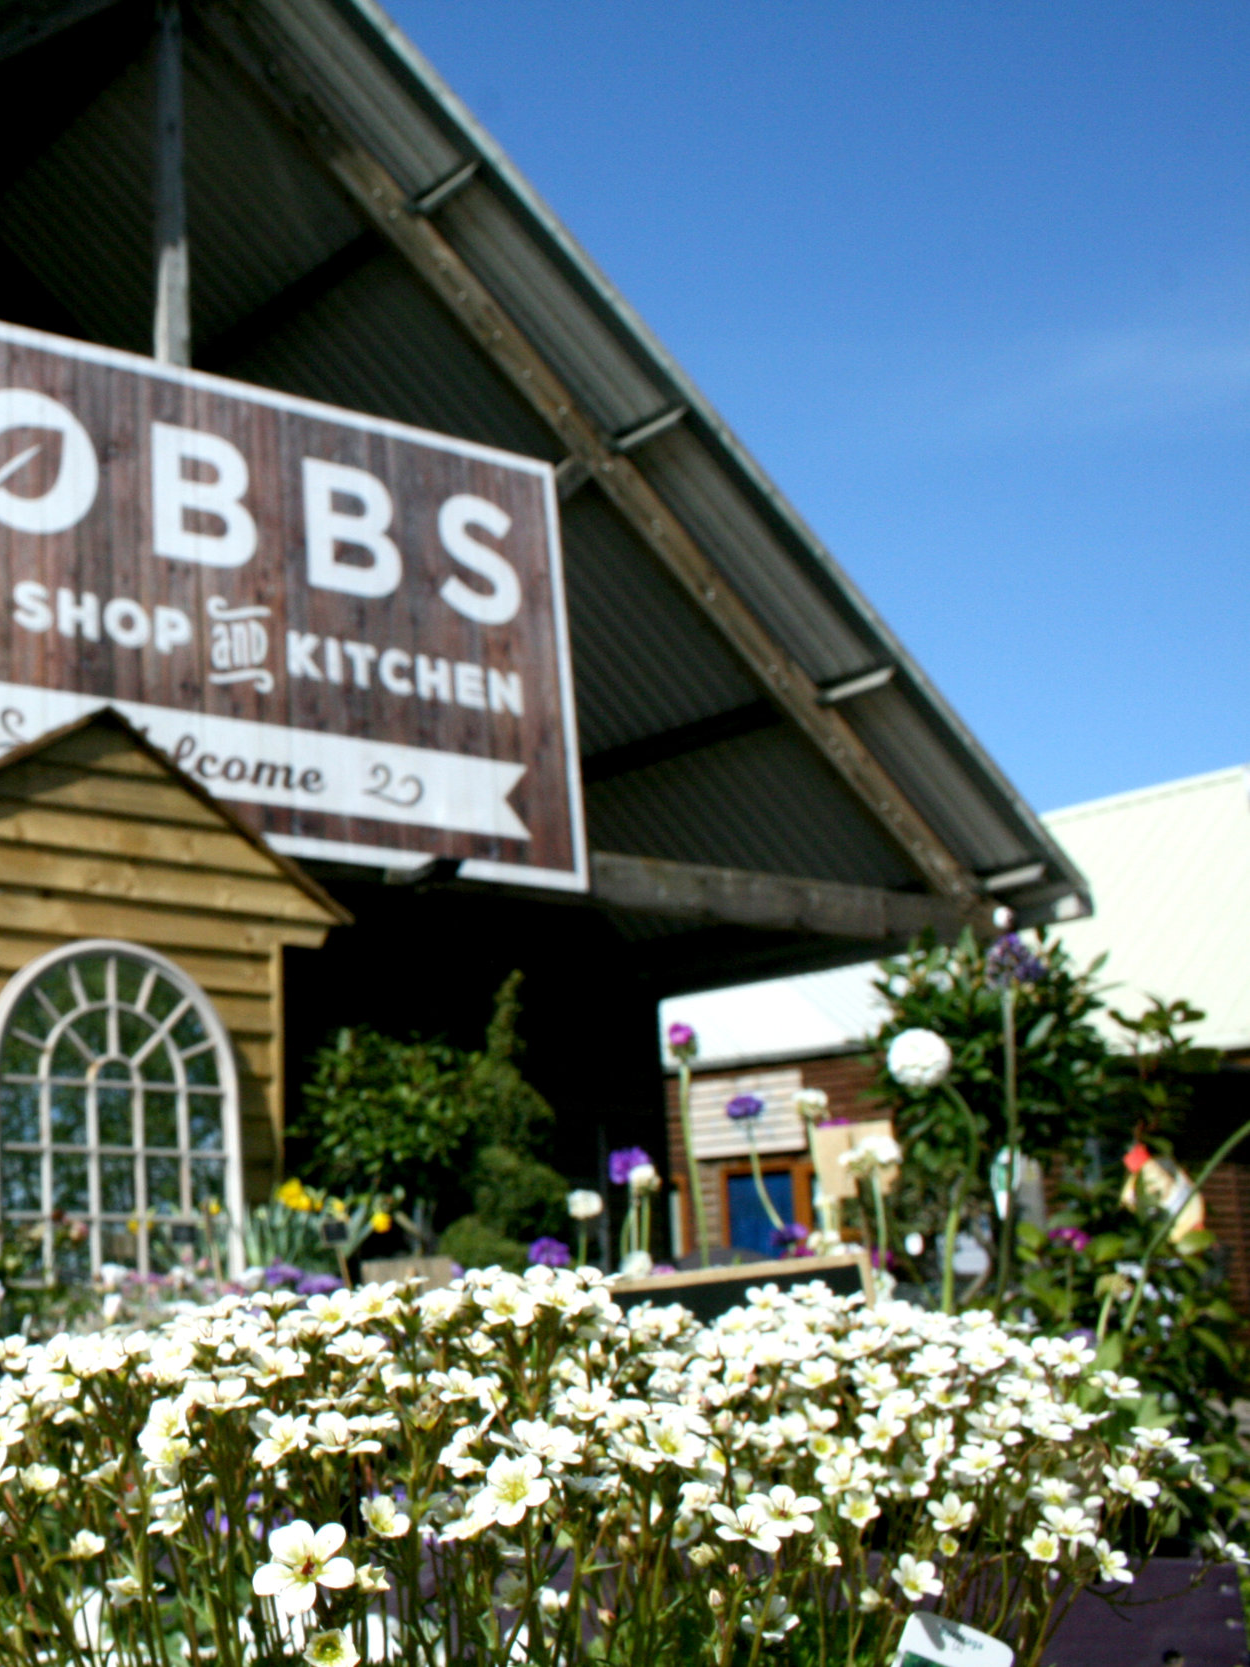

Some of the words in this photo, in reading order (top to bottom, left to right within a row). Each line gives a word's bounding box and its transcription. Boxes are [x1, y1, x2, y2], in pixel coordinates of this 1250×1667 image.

[12, 582, 191, 654] SHOP
[286, 629, 523, 717] KITCHEN
[139, 727, 324, 793] lcome
